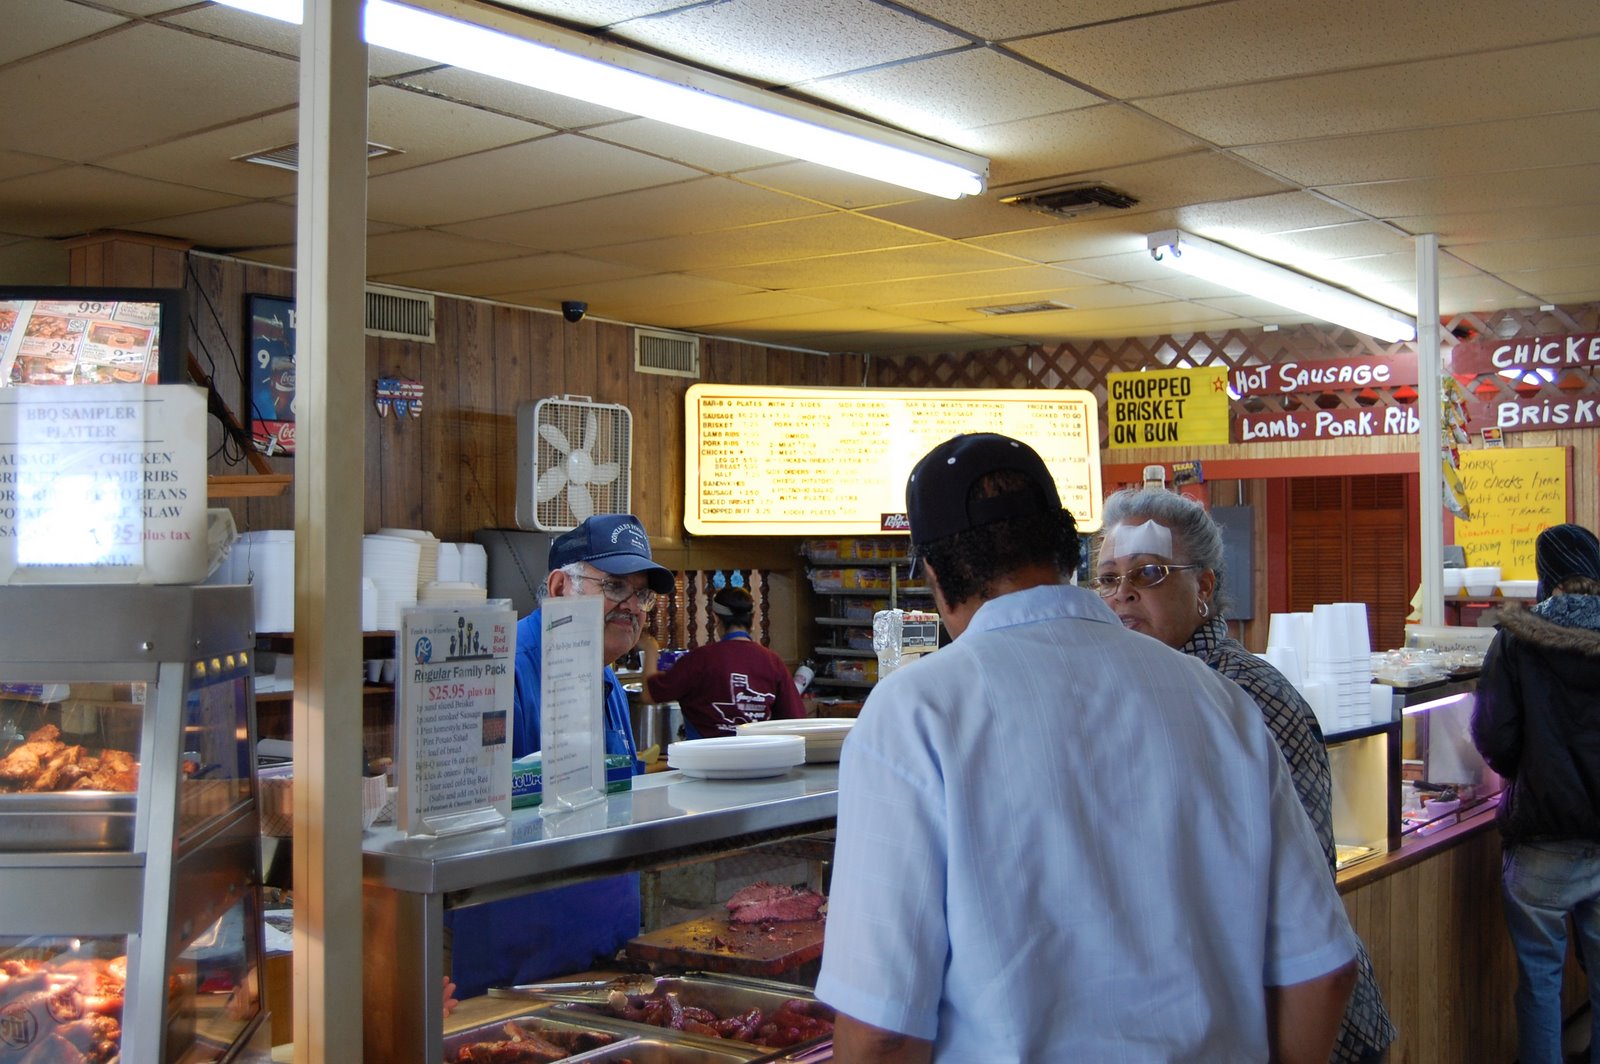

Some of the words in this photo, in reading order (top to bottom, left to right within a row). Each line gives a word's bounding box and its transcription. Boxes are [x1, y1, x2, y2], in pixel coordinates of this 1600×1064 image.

[258, 350, 270, 368] 9
[1113, 376, 1191, 400] CHOPPED
[27, 408, 58, 422] BBQ
[62, 406, 136, 420] SAMPLER
[1116, 399, 1185, 422] BRISKET
[46, 426, 116, 438] PLATTER
[1115, 424, 1136, 443] ON
[1144, 422, 1178, 442] BUN
[100, 452, 173, 465] CHICKEN
[144, 470, 178, 482] RIBS
[137, 488, 188, 500] BEANS
[884, 516, 910, 528] Peppe
[170, 530, 192, 542] tax
[494, 625, 505, 633] Big
[418, 640, 432, 656] RC
[415, 669, 451, 682] Regular
[454, 666, 482, 678] Family
[485, 664, 506, 676] Pack
[428, 684, 465, 701] $25.95
[467, 688, 483, 699] plus
